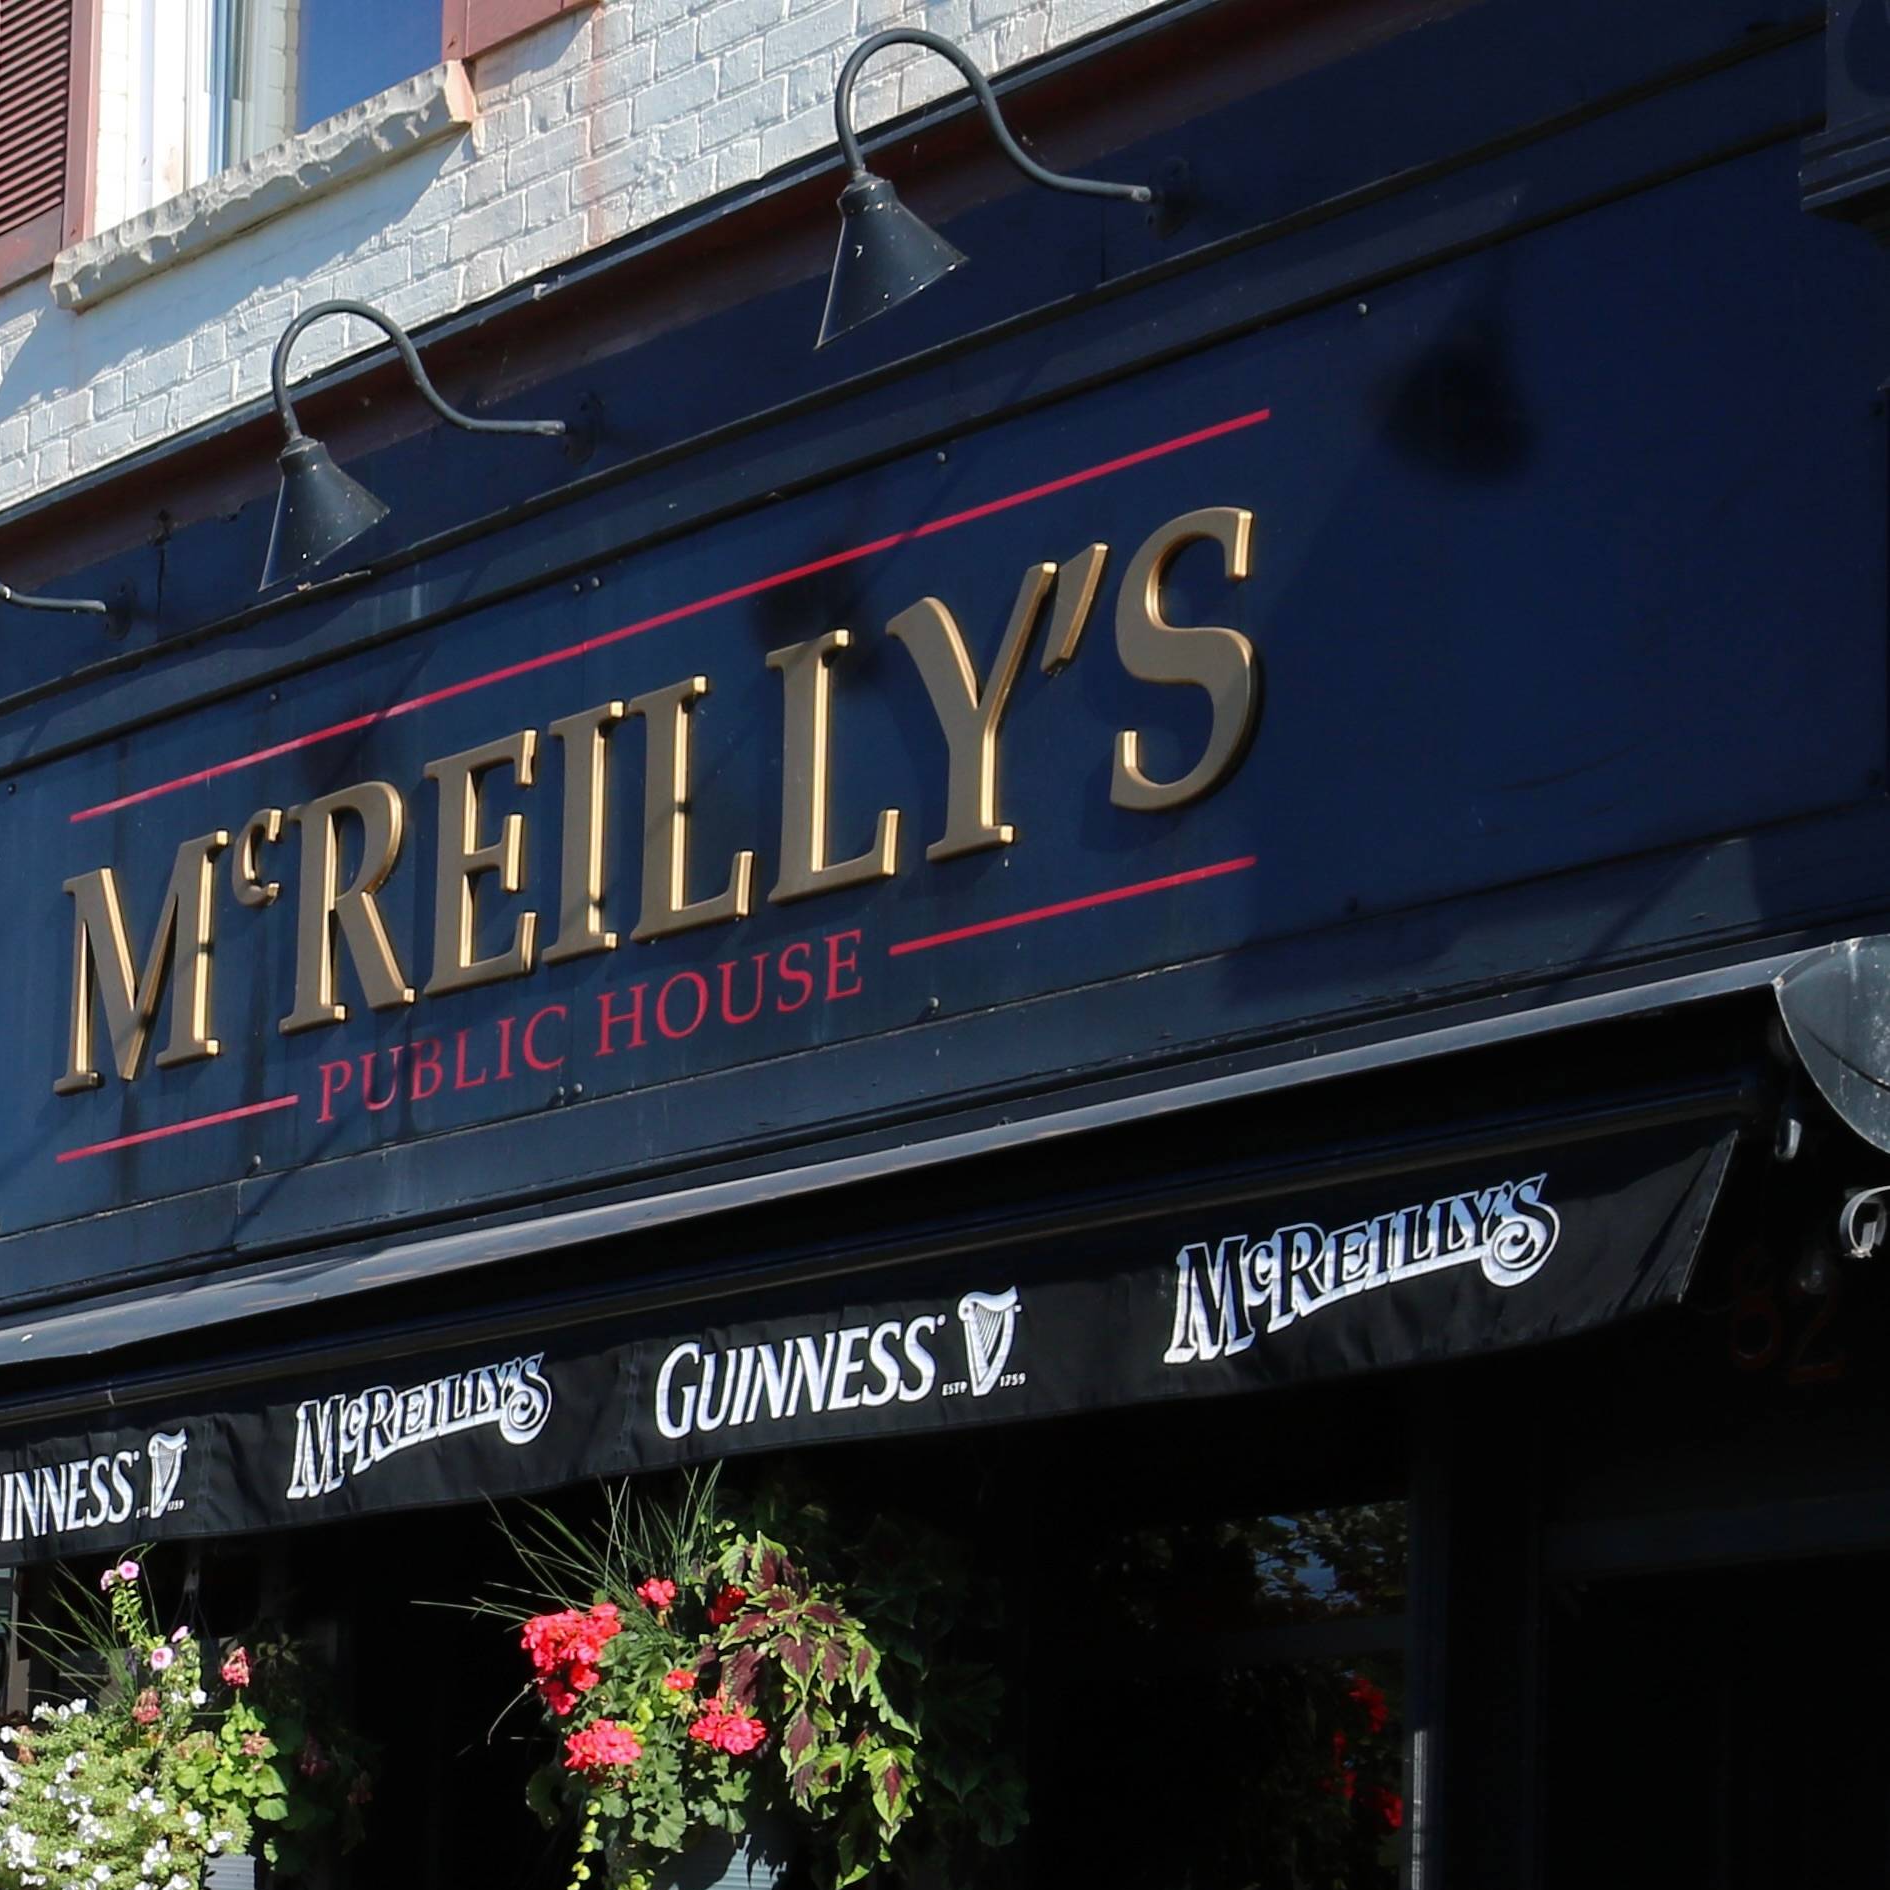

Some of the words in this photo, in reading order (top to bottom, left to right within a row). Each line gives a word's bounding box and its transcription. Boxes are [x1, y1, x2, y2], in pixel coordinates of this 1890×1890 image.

[315, 1003, 567, 1125] PUBLIC
[597, 928, 866, 1063] HOUSE
[655, 1314, 937, 1440] GUINNESS
[999, 1372, 1027, 1388] 1759
